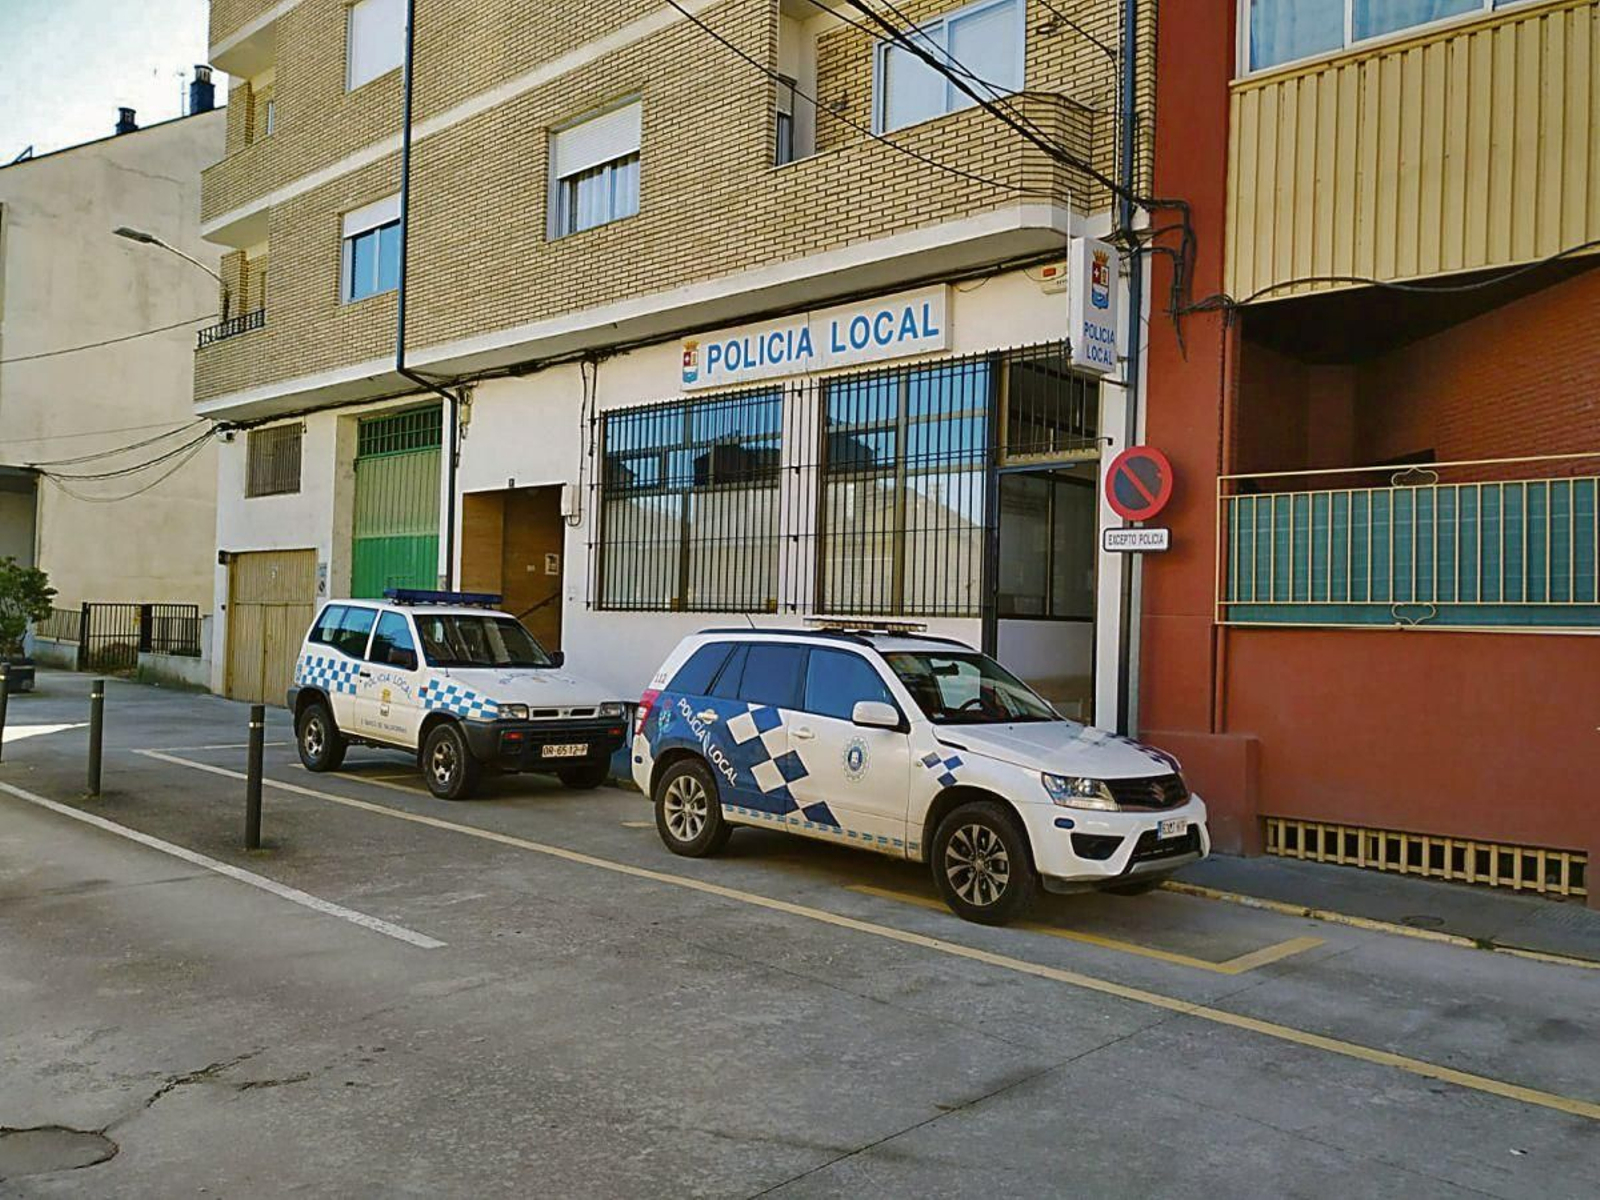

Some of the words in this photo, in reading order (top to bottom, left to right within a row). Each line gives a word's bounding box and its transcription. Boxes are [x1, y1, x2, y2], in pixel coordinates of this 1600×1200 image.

[707, 327, 814, 374] POLICIA
[831, 303, 940, 353] LOCAL
[1084, 321, 1116, 345] POLICIA
[1086, 344, 1113, 366] LOCAL
[1108, 533, 1137, 546] EXCEPTO
[1139, 533, 1164, 545] POLICIA
[708, 744, 739, 788] LOCAL
